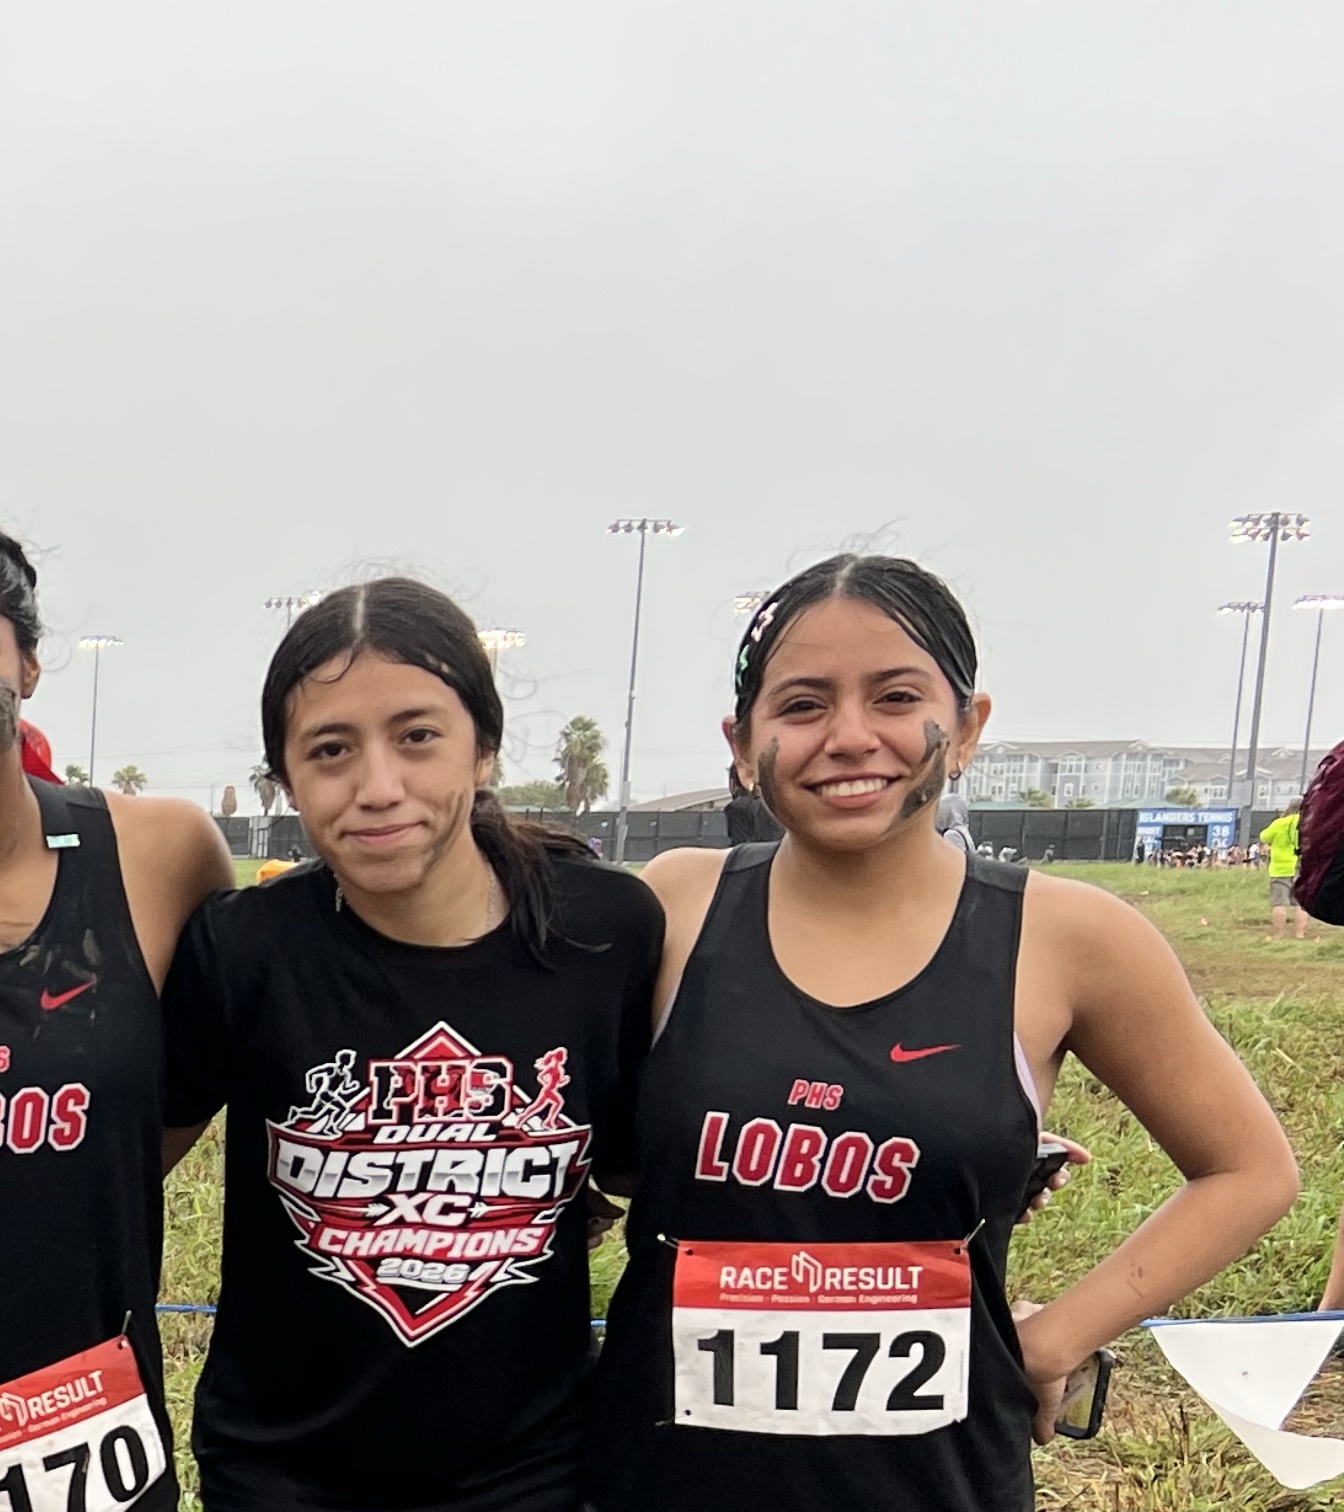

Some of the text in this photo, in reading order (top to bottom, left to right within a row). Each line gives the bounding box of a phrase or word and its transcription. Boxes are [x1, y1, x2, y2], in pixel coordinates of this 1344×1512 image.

[1212, 825, 1230, 837] 38
[367, 1057, 513, 1125] PHS
[787, 1079, 844, 1110] PHS
[372, 1123, 497, 1145] DUAL
[275, 1139, 580, 1198] DISTRICT
[695, 1111, 921, 1204] LOBOS
[373, 1192, 472, 1227] XC
[316, 1226, 545, 1256] CHAMPIONS
[719, 1265, 923, 1290] RACE RESULT
[697, 1329, 946, 1411] 1172
[27, 1370, 104, 1420] RESULT
